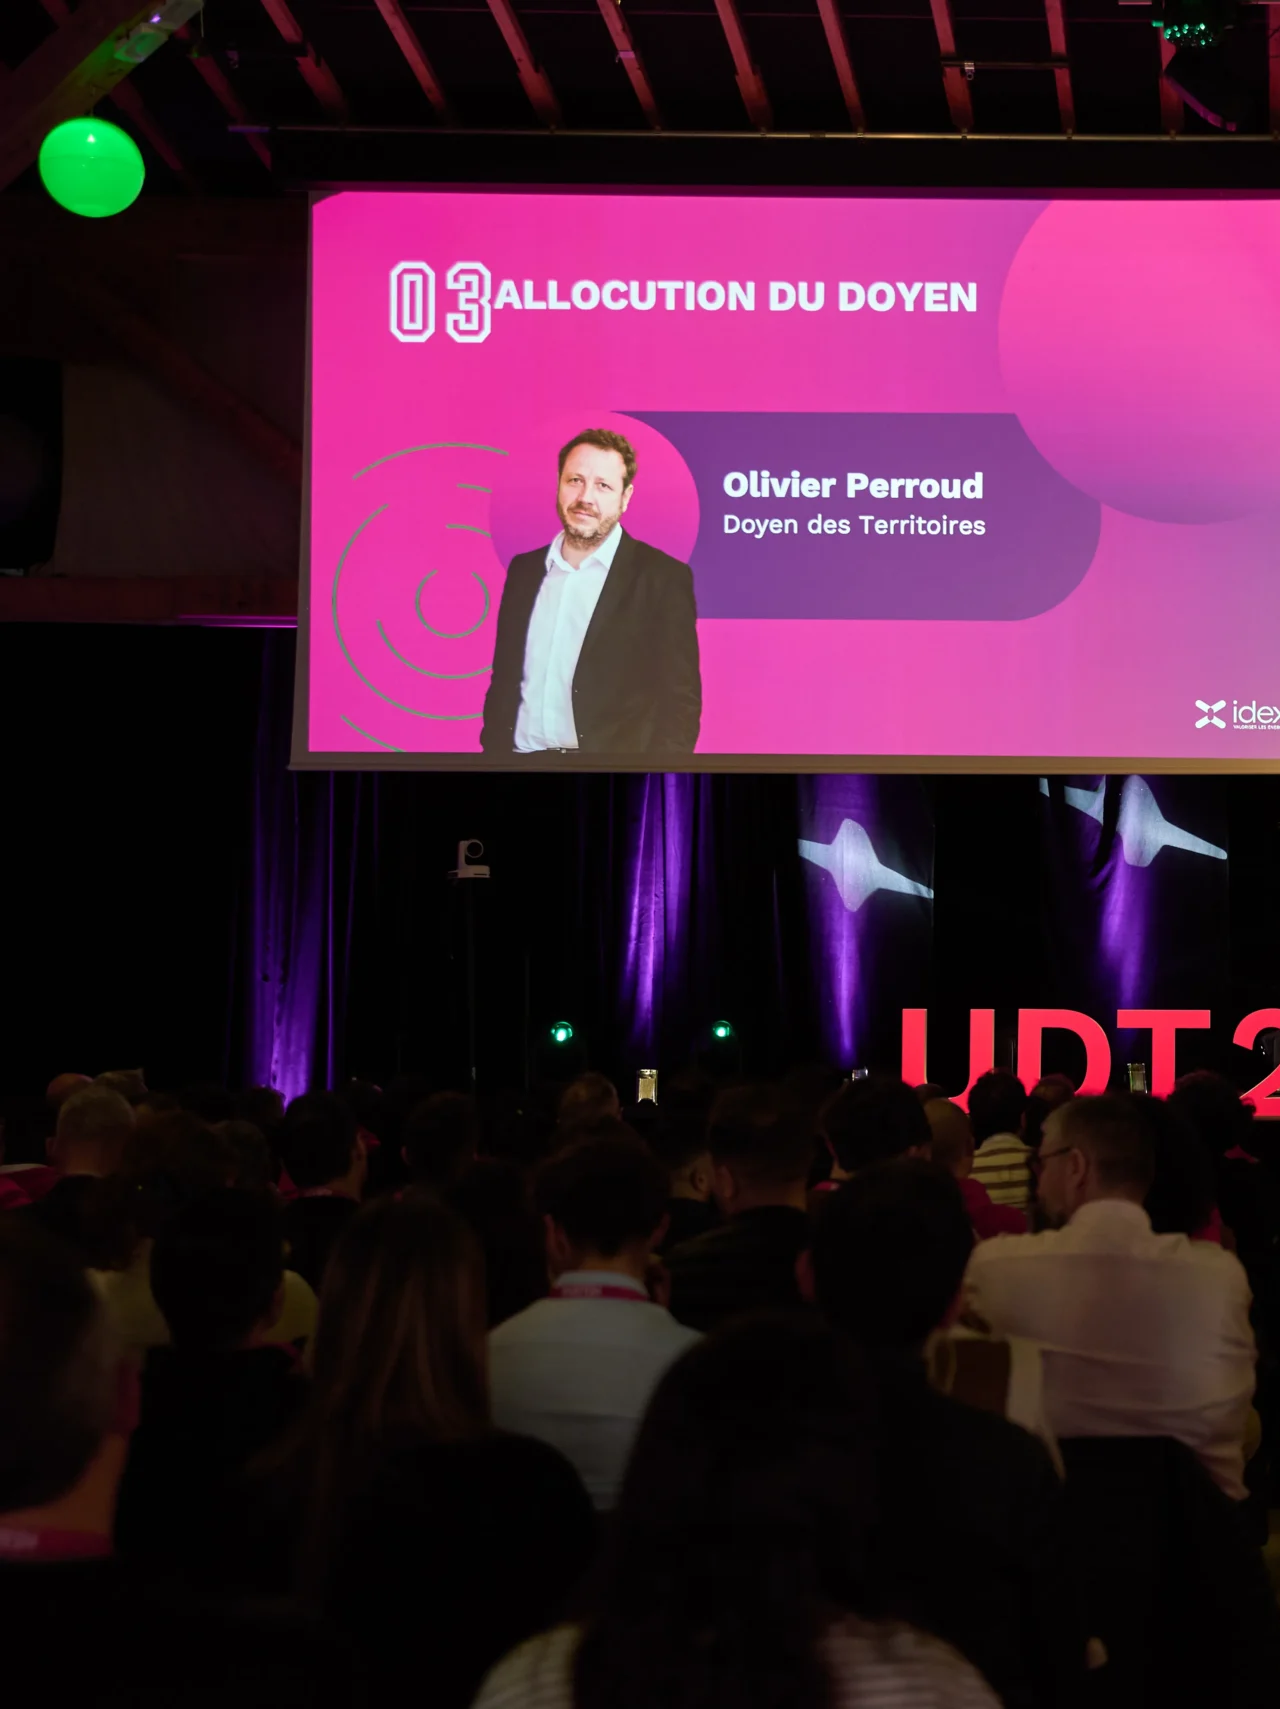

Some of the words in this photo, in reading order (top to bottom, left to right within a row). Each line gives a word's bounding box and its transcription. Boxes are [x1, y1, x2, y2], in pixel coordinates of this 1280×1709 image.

[389, 261, 492, 343] 03
[493, 279, 755, 311] ALLOCUTION
[769, 280, 825, 311] DU
[838, 281, 977, 312] DOYEN
[723, 470, 837, 498] Olivier
[846, 472, 984, 499] Perroud
[723, 514, 798, 539] Doyen
[807, 513, 851, 535] des
[858, 514, 986, 535] Territoires
[902, 1008, 1211, 1115] UDT
